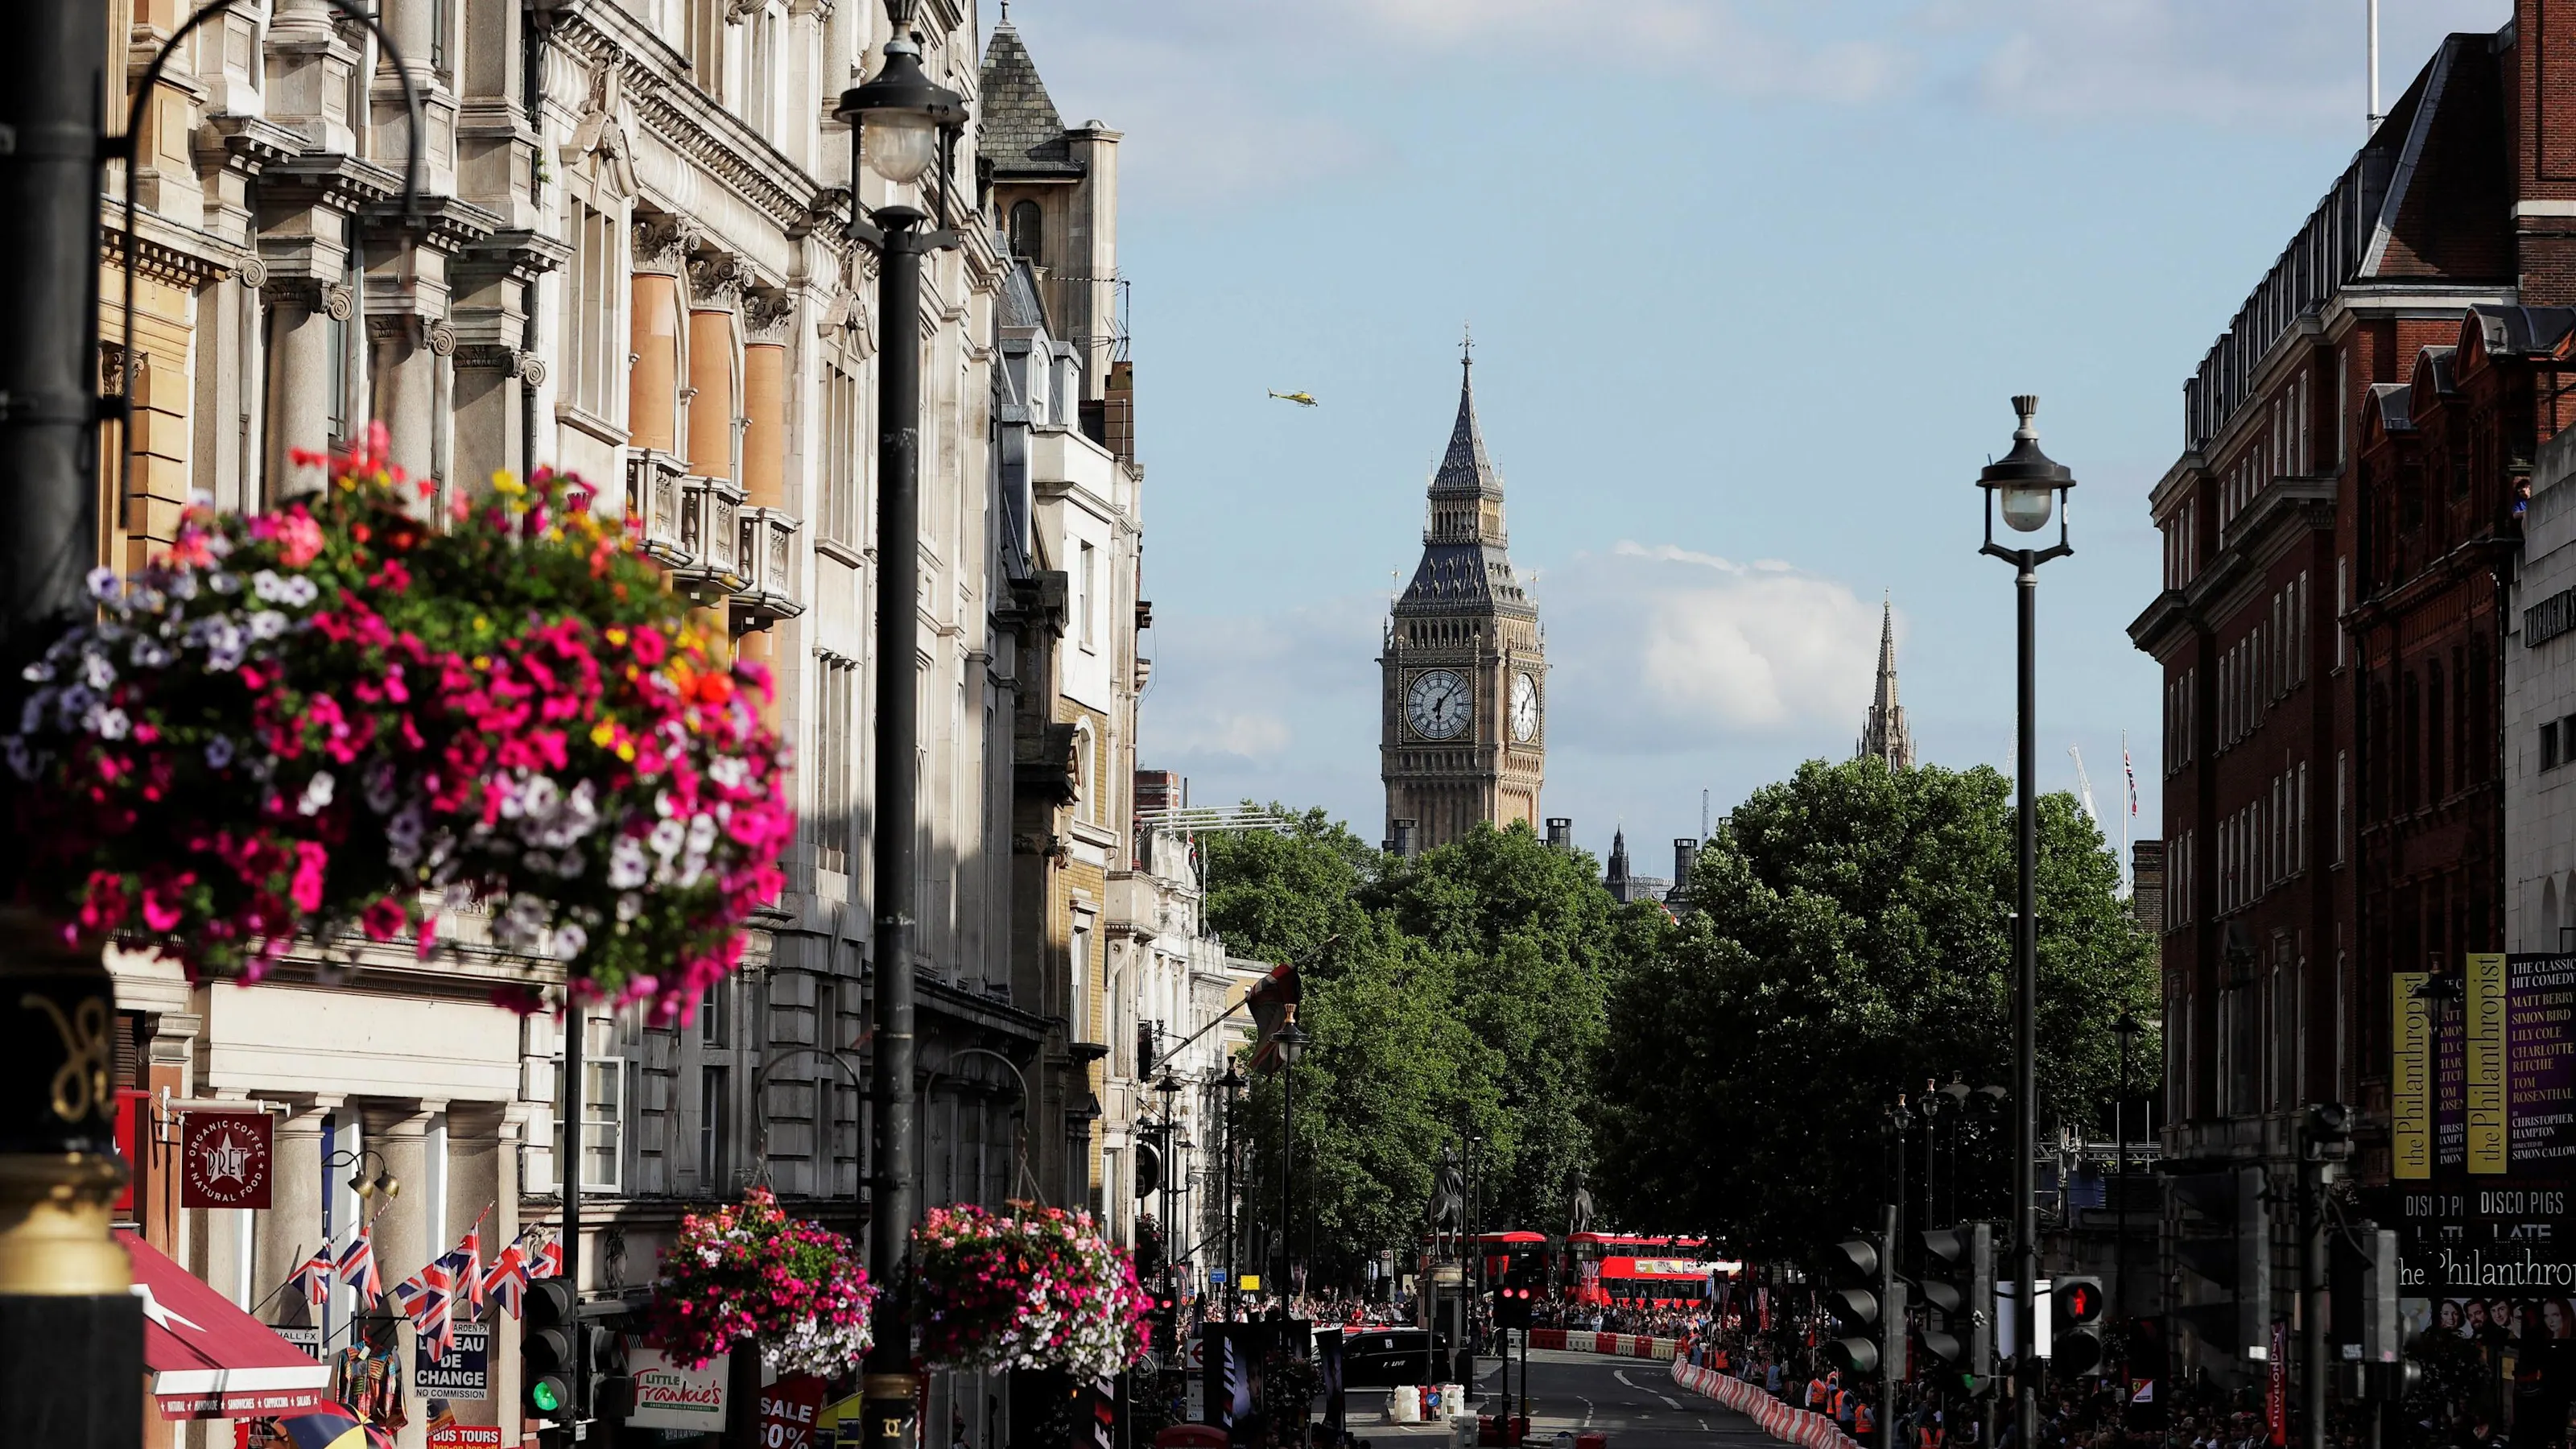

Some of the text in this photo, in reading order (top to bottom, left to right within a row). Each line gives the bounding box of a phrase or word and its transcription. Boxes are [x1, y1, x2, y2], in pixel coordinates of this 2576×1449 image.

[2512, 962, 2533, 975] THE
[2512, 971, 2576, 989] HIT COMEDY
[2512, 991, 2574, 1008] MATT BERRY
[2512, 1009, 2572, 1025] SIMON BIRD
[2512, 1026, 2562, 1042] LILY COLE
[2512, 1042, 2574, 1059] CHARLOTTE
[2467, 956, 2507, 1162] the Philanthropist
[2512, 1059, 2554, 1072] RITCHIE
[2512, 1076, 2536, 1089] TOM
[2512, 1088, 2574, 1103] ROSENTHAL
[2512, 1113, 2574, 1127] CHRISTOPHER
[188, 1120, 266, 1158] ORGANIC COFFEE
[2512, 1127, 2555, 1139] HAMPTON
[2401, 1139, 2424, 1166] the
[2512, 1145, 2576, 1160] SIMON CALLOW
[206, 1147, 248, 1177] PRET
[191, 1172, 262, 1202] NATURAL FOOD
[2480, 1191, 2564, 1214] DISCO PIGS
[2399, 1257, 2425, 1286] he
[2438, 1248, 2576, 1293] hilanthro
[440, 1354, 461, 1368] DE
[1224, 1335, 1236, 1396] LIVE
[416, 1370, 485, 1386] CHANGE
[646, 1374, 680, 1385] LITTLE
[416, 1389, 485, 1398] NO COMMISSION
[633, 1368, 722, 1406] Frankie's
[228, 1397, 255, 1410] SANDWICHES
[263, 1396, 289, 1408] CAPPUCCINO
[296, 1395, 312, 1406] SALADS
[760, 1397, 813, 1423] SALE
[433, 1430, 498, 1443] BUS TOURS
